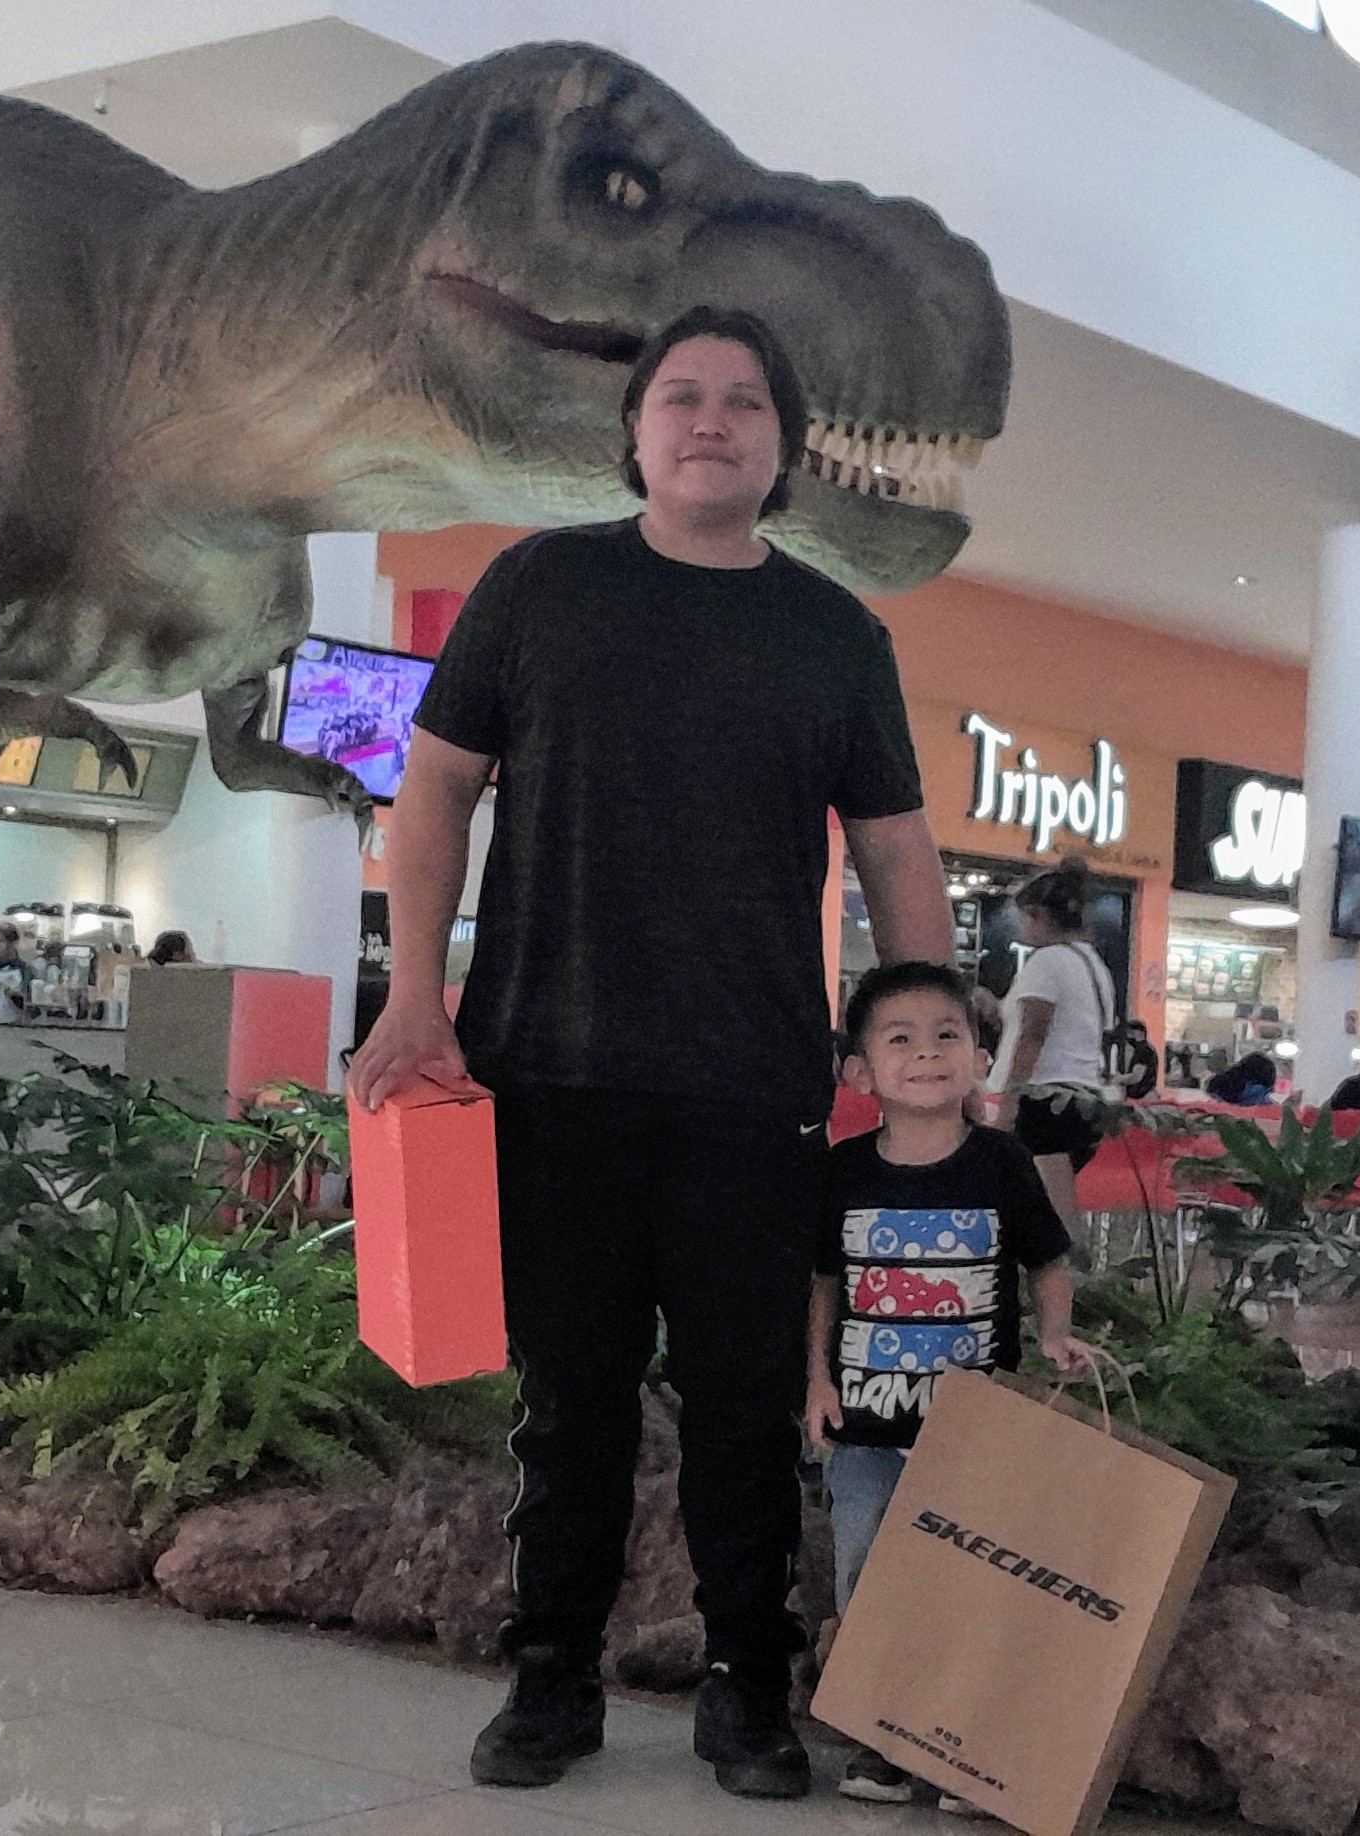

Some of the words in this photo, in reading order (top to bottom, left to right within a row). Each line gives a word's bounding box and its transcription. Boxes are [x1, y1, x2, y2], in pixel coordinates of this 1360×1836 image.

[962, 712, 1126, 853] Tripoli
[841, 1367, 939, 1420] GAM
[911, 1511, 1126, 1622] SKECHERS
